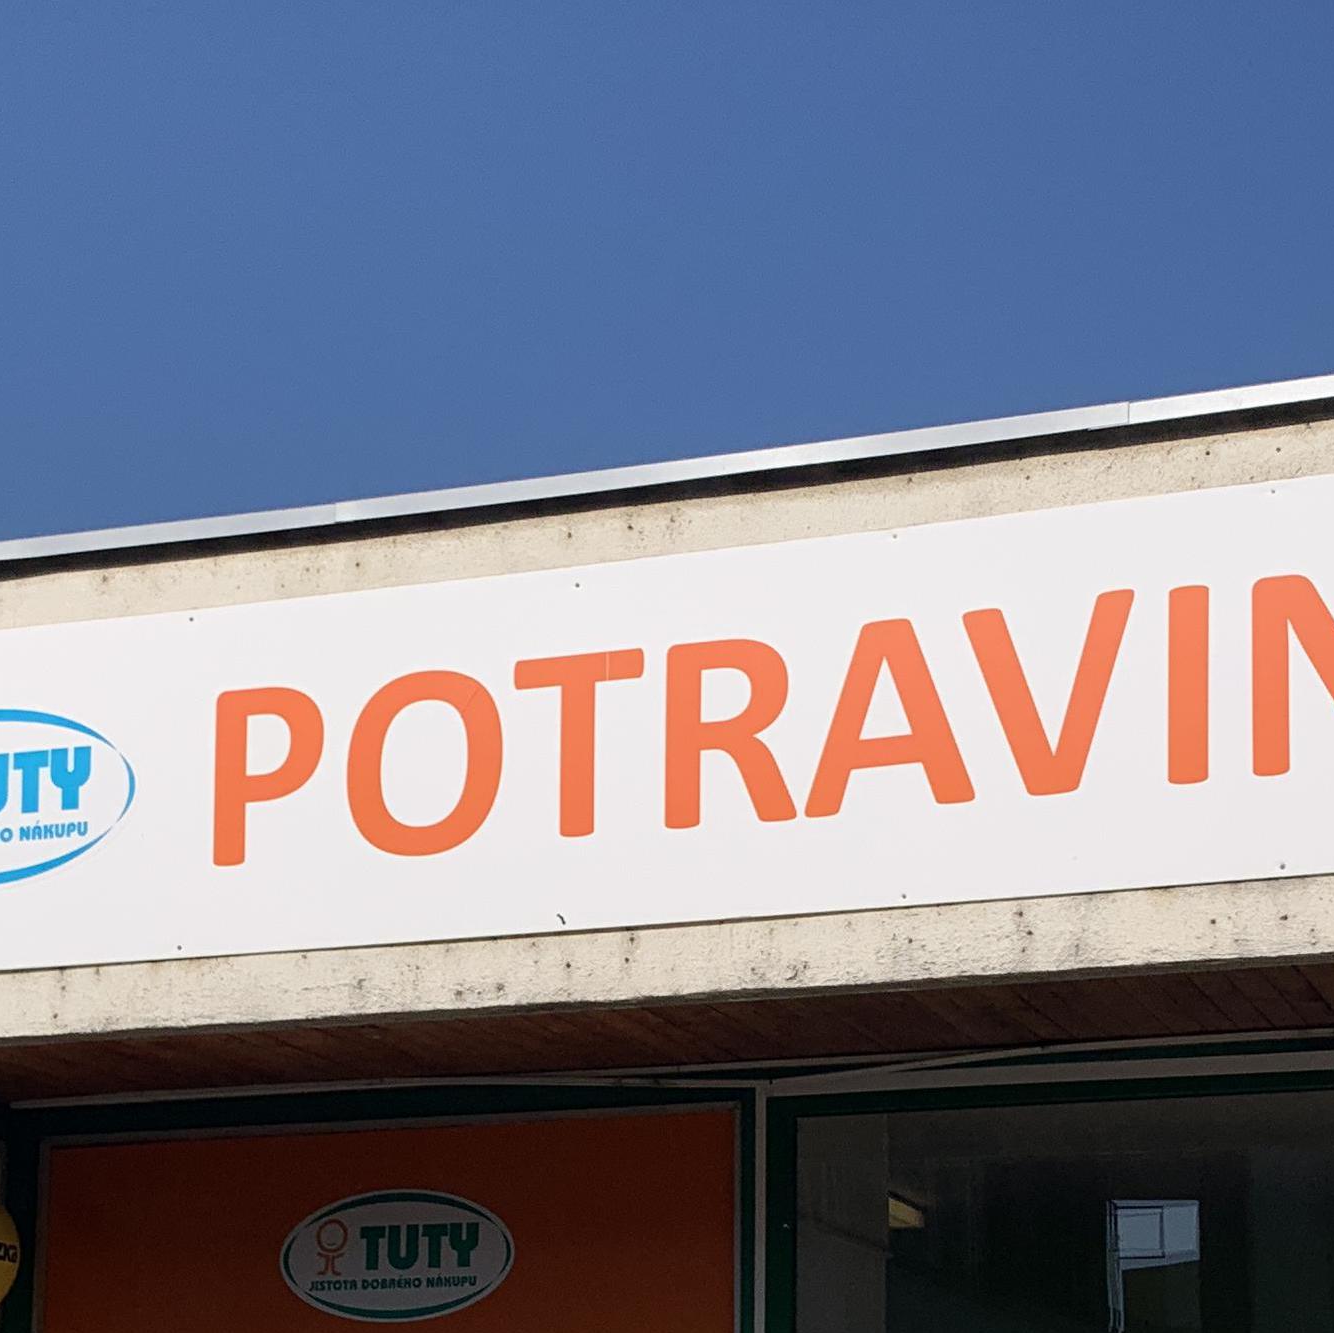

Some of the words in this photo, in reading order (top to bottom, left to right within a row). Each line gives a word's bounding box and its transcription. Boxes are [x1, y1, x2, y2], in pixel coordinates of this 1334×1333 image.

[18, 819, 89, 844] NÁKUPU
[360, 1221, 480, 1271] TUTY
[309, 1278, 358, 1293] JISTOTA
[362, 1274, 423, 1291] DOBRÉHO
[426, 1273, 477, 1288] NÁKUPU
